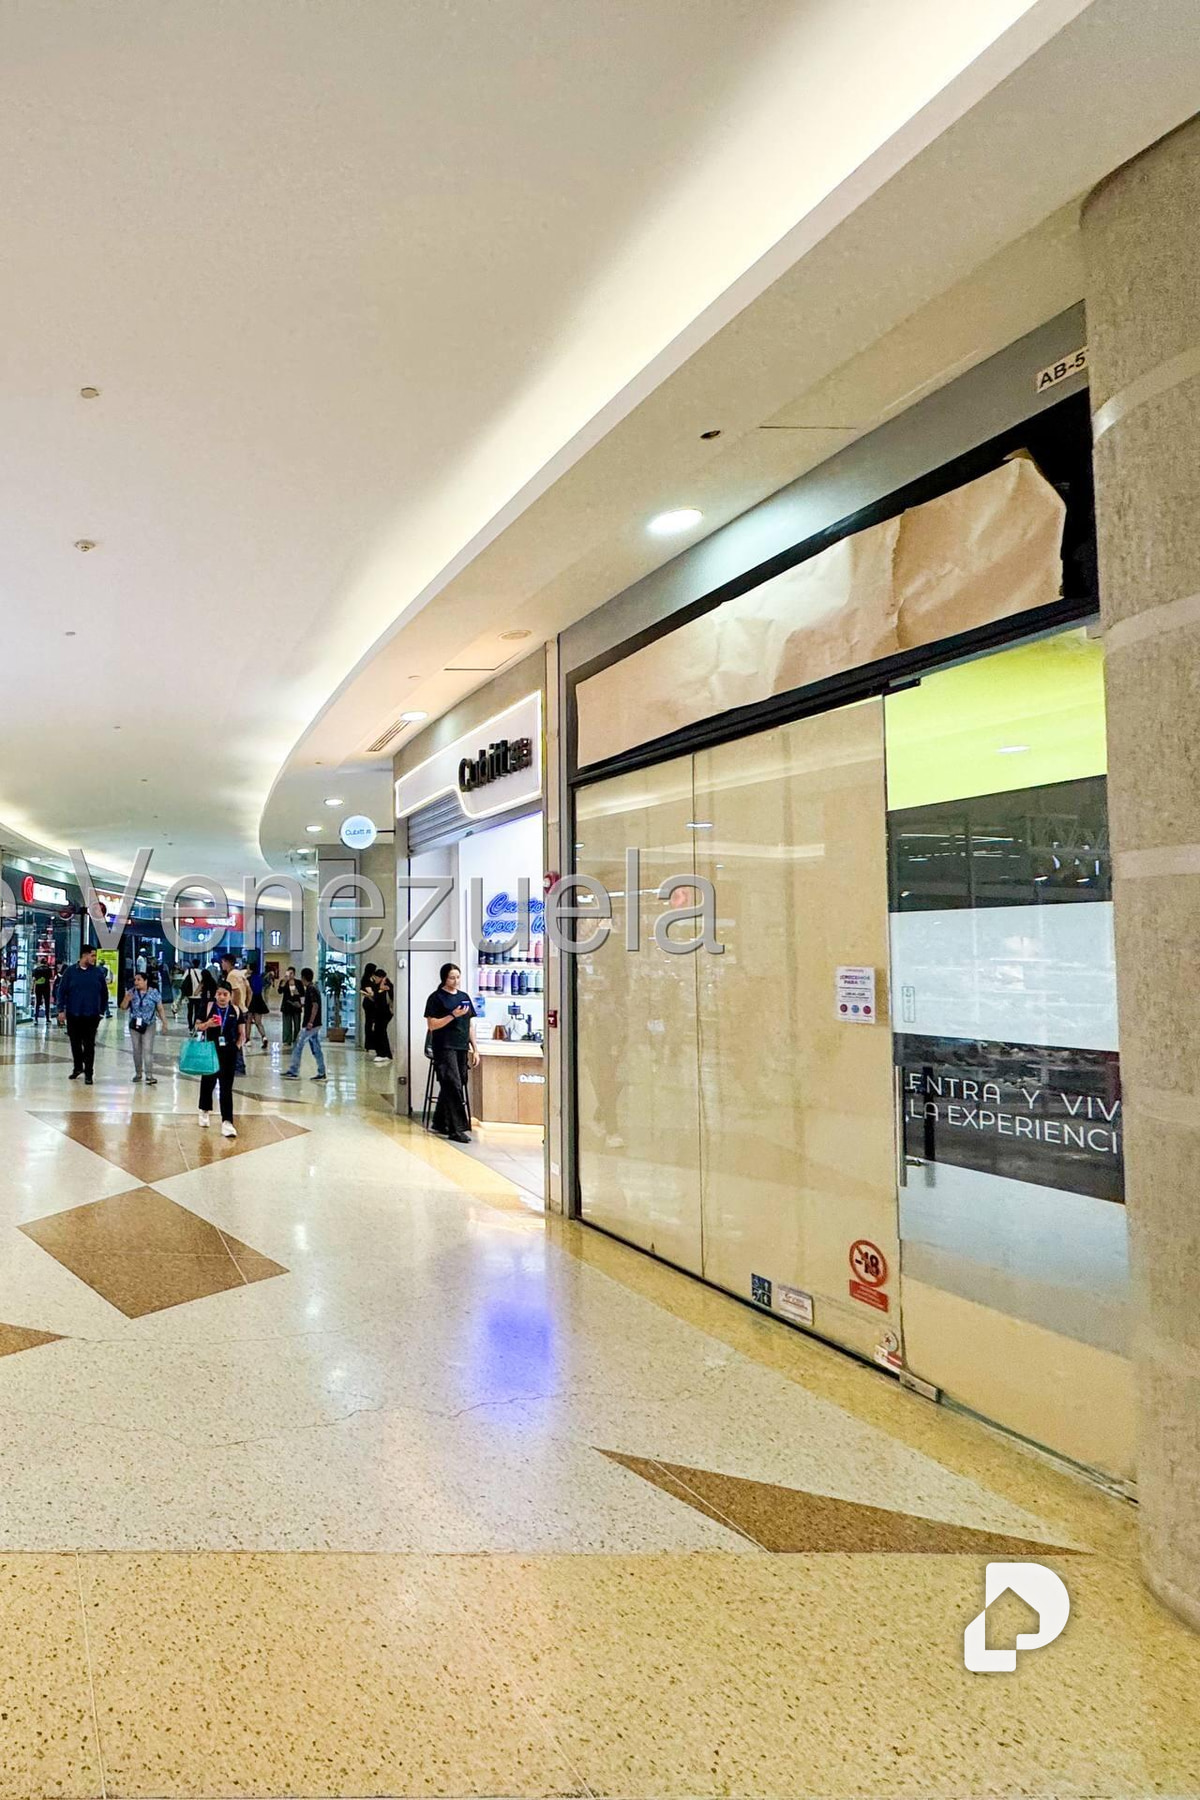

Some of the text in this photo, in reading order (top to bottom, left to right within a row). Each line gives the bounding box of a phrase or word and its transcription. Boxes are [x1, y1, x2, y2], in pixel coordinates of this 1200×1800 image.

[909, 1073, 1000, 1105] ENTRA
[1022, 1087, 1040, 1110] Y
[910, 1099, 1118, 1154] LA EXPERIENCI
